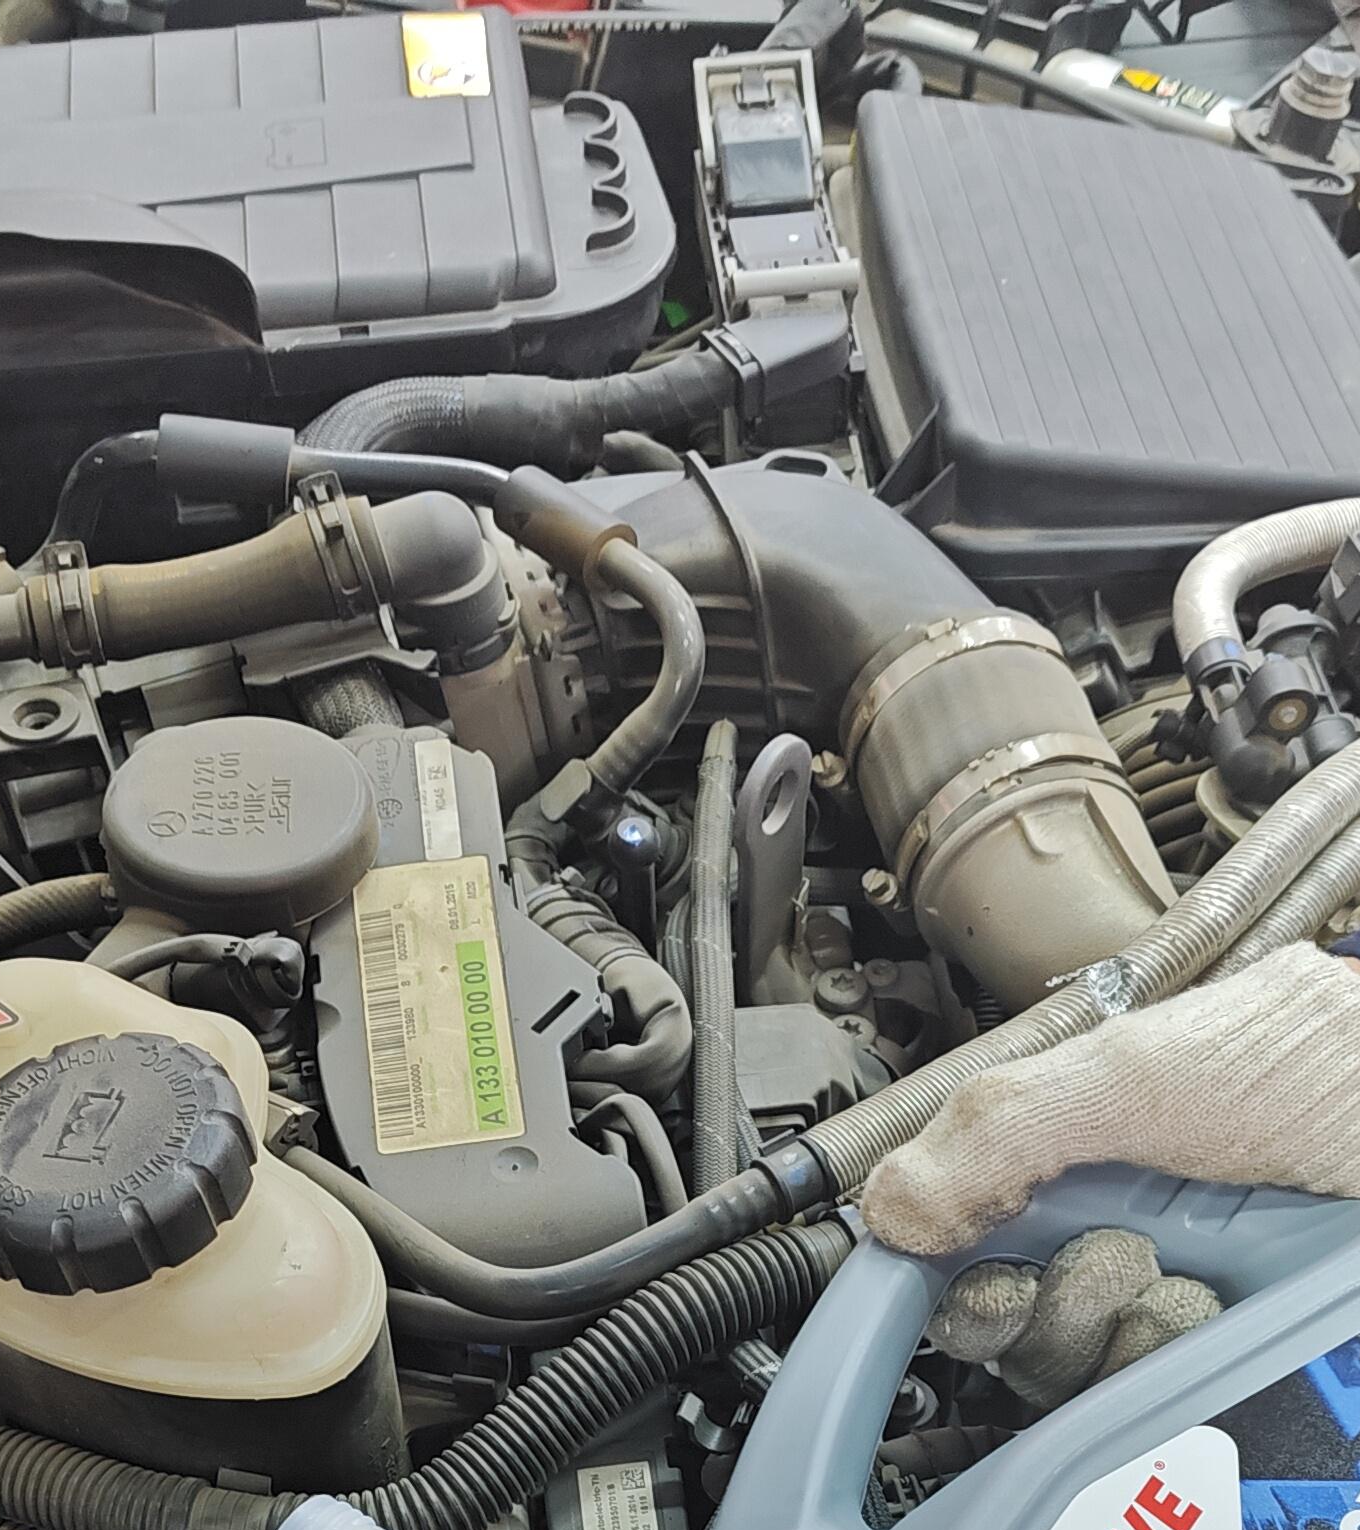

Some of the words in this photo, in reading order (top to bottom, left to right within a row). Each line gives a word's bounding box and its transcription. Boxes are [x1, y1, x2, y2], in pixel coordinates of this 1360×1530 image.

[461, 959, 486, 985] 00
[465, 989, 491, 1015] 00
[469, 1019, 497, 1058] 010
[474, 1063, 502, 1103] 133
[480, 1108, 506, 1127] A
[55, 1186, 104, 1213] HOT
